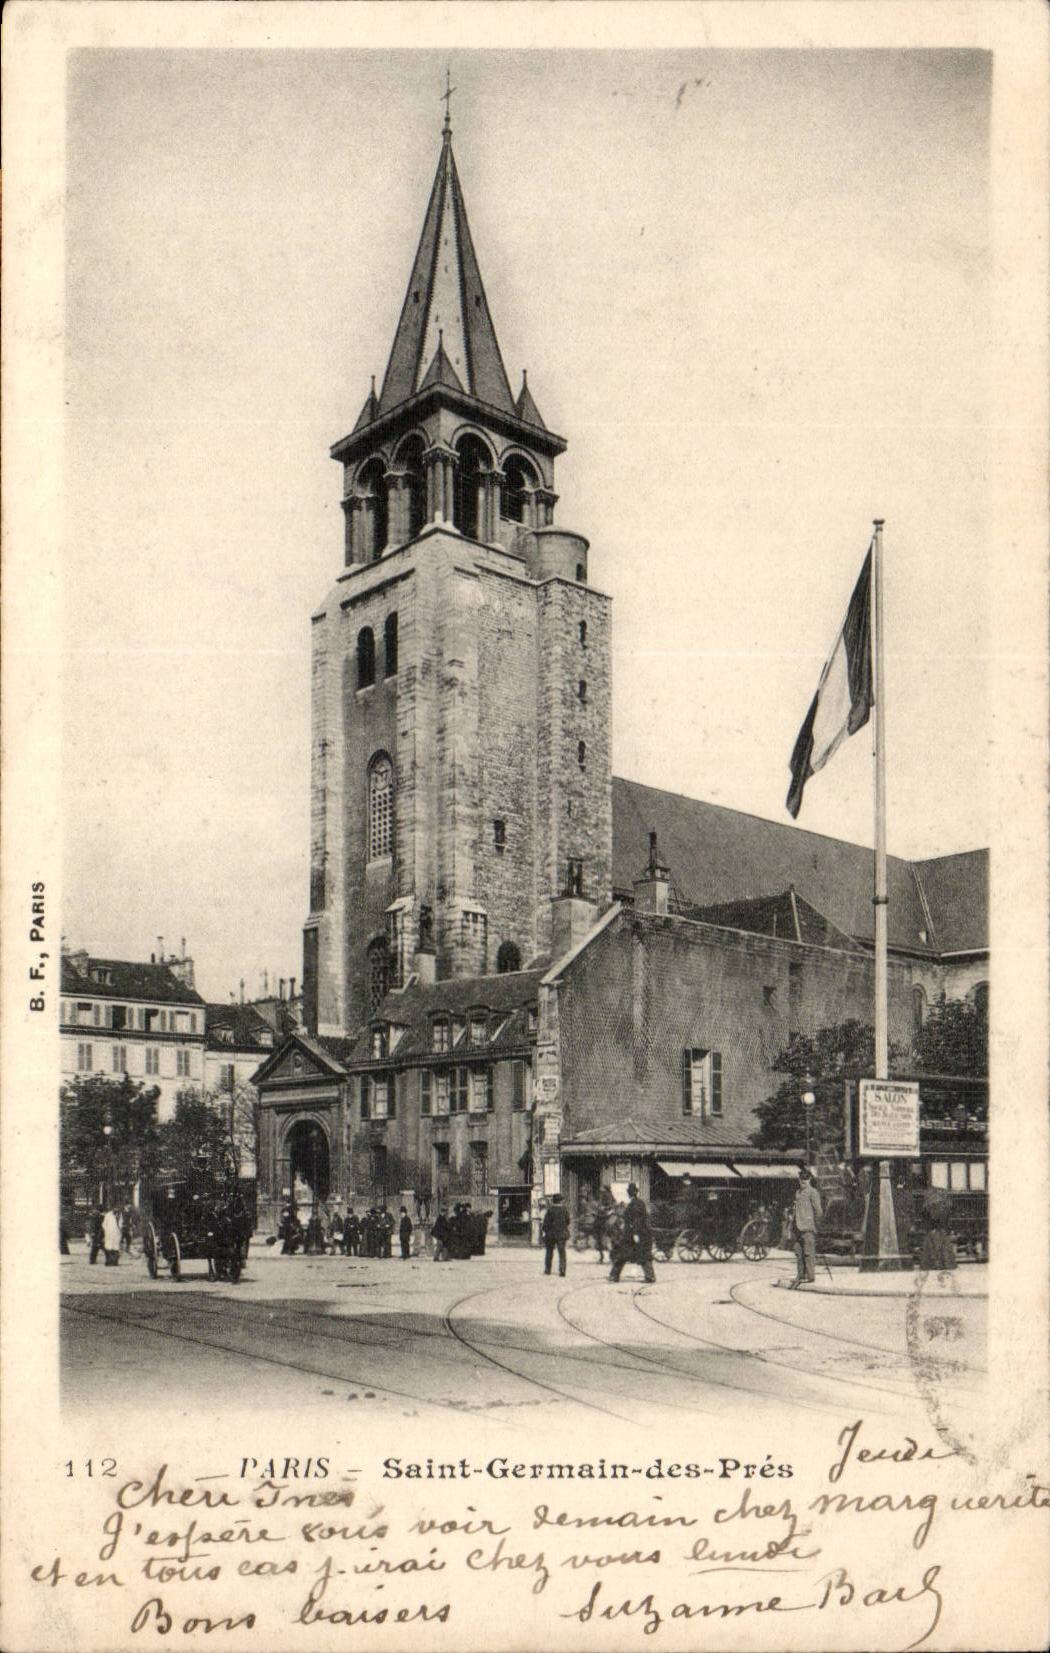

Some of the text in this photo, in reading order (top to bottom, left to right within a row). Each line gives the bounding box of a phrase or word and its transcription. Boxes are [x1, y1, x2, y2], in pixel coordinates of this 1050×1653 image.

[874, 1092, 908, 1104] SALON
[828, 1419, 964, 1484] Jeudi
[408, 1506, 512, 1536] voir
[533, 1496, 699, 1530] demain
[31, 1556, 66, 1588] et
[74, 1571, 125, 1589] en
[142, 1554, 222, 1583] tous
[237, 1558, 299, 1577] cas
[560, 1549, 661, 1571] vous
[684, 1530, 822, 1563] lundi
[130, 1597, 257, 1636] Bons
[292, 1584, 451, 1626] baisers
[558, 1580, 816, 1636] Suzanne
